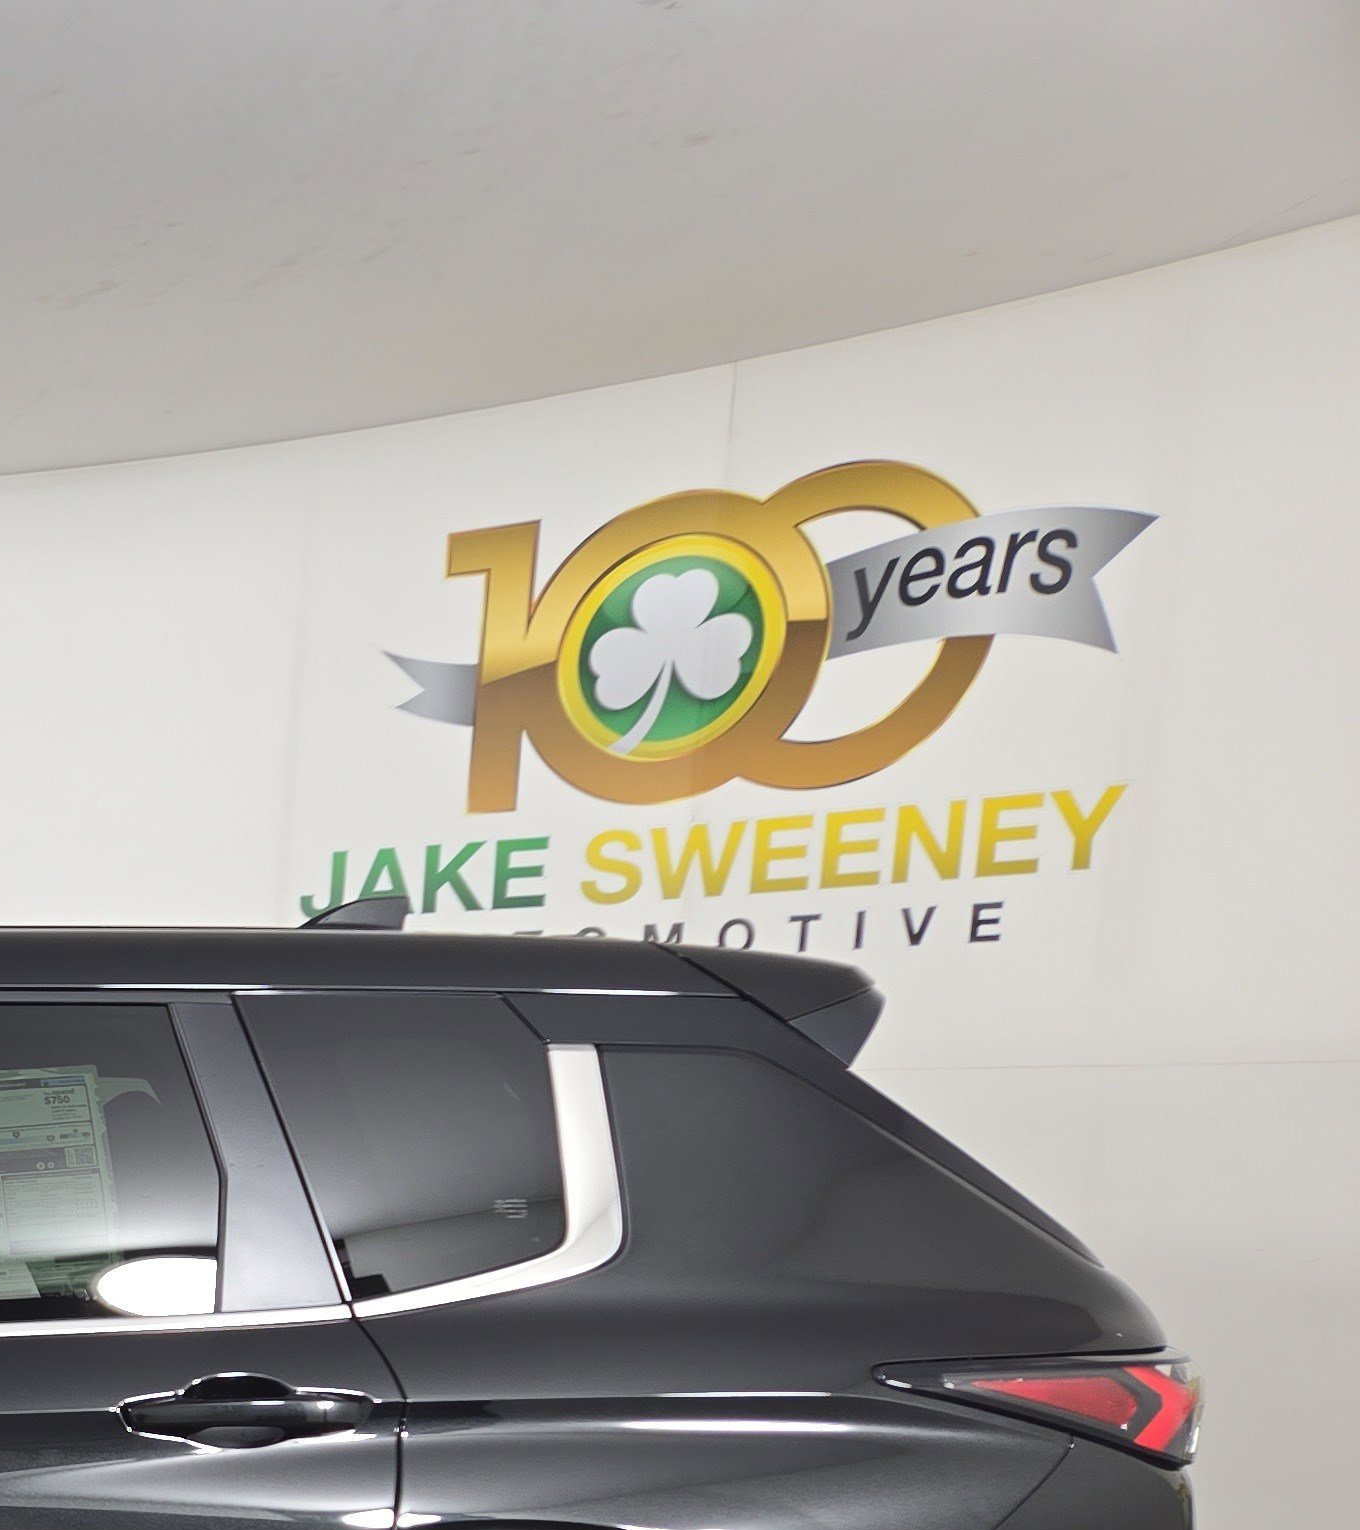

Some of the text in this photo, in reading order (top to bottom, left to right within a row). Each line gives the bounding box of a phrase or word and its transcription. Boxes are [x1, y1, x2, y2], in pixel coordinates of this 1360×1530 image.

[445, 458, 1078, 815] 100 years
[299, 783, 1129, 919] JAKE SWEENEY
[514, 901, 1005, 951] MOTIVE
